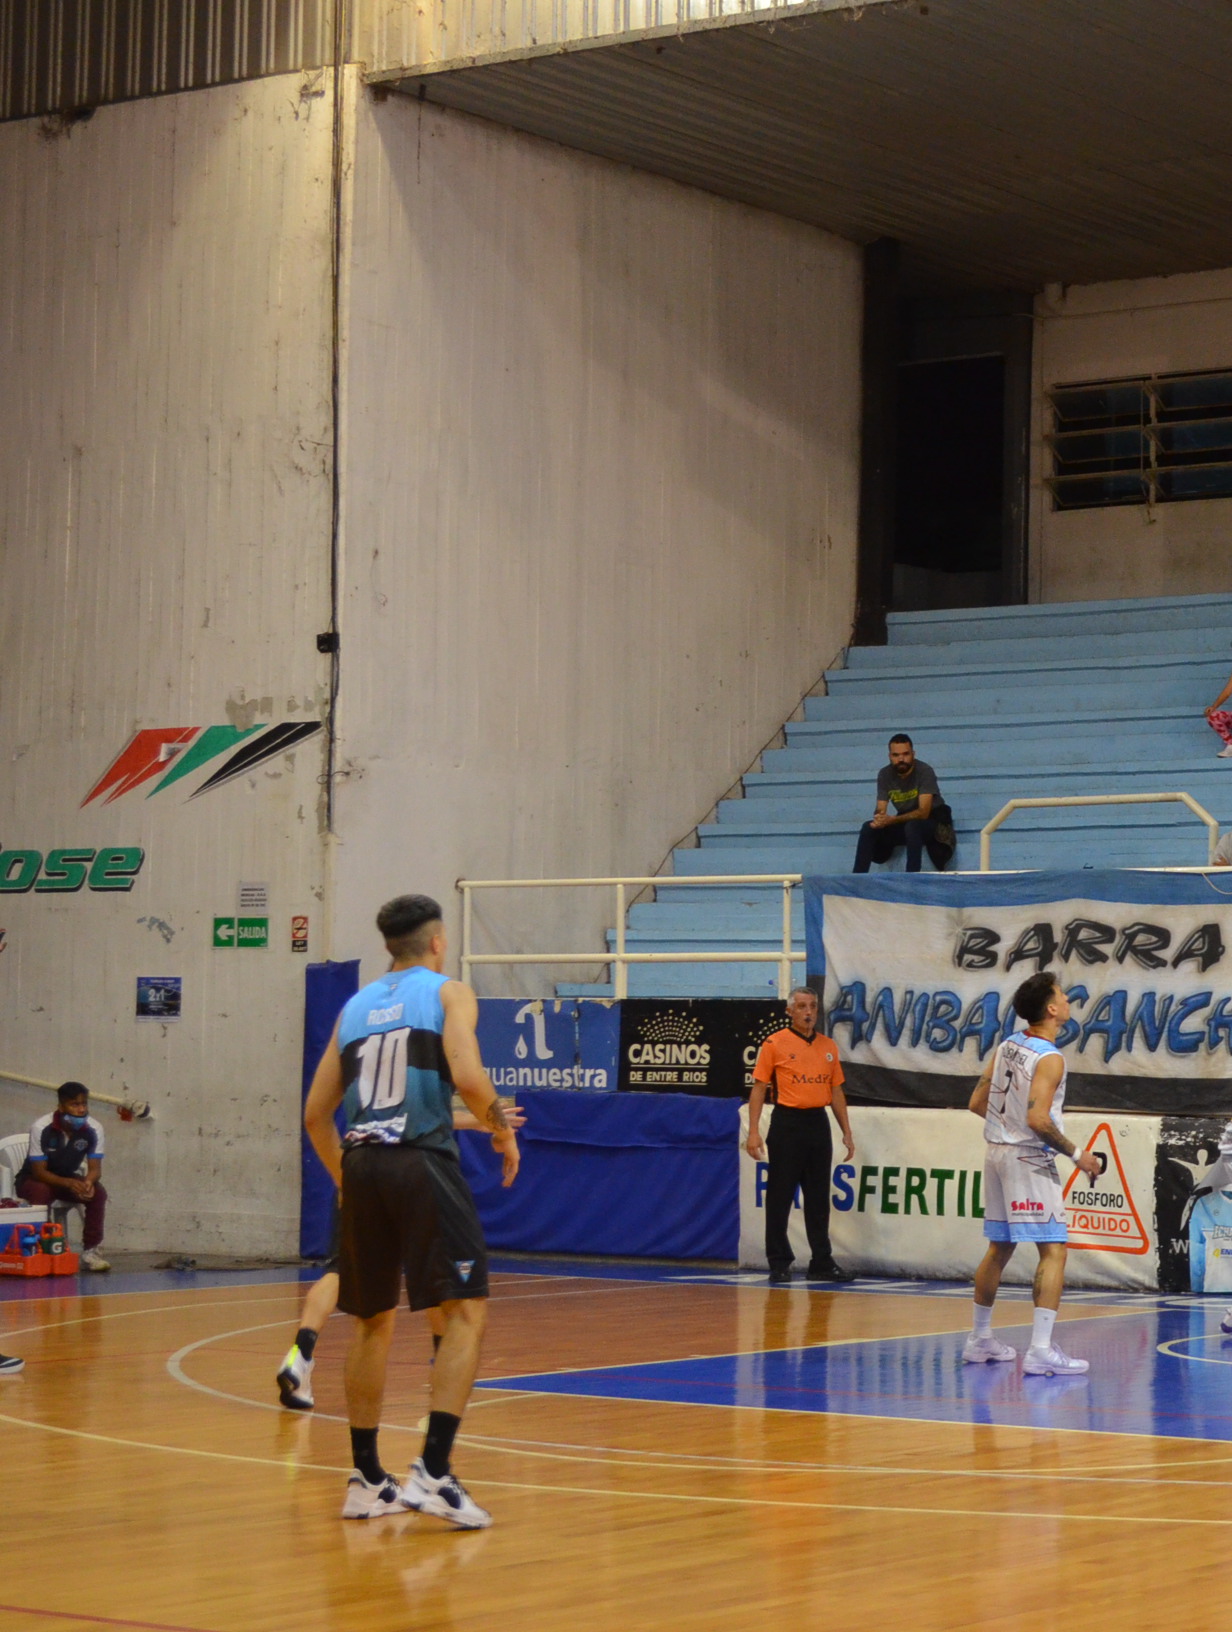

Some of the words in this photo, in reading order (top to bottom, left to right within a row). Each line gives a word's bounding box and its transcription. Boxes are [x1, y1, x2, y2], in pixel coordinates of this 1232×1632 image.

[0, 847, 145, 893] ose
[238, 927, 267, 939] SALIDA
[956, 918, 1225, 972] BARRA
[357, 1027, 411, 1110] 10
[628, 1043, 711, 1065] CASINOS
[629, 1071, 643, 1081] DE
[646, 1071, 679, 1082] ENTRE
[682, 1072, 707, 1082] RIOS
[1000, 1070, 1013, 1114] 7
[1071, 1190, 1124, 1208] FOSFORO
